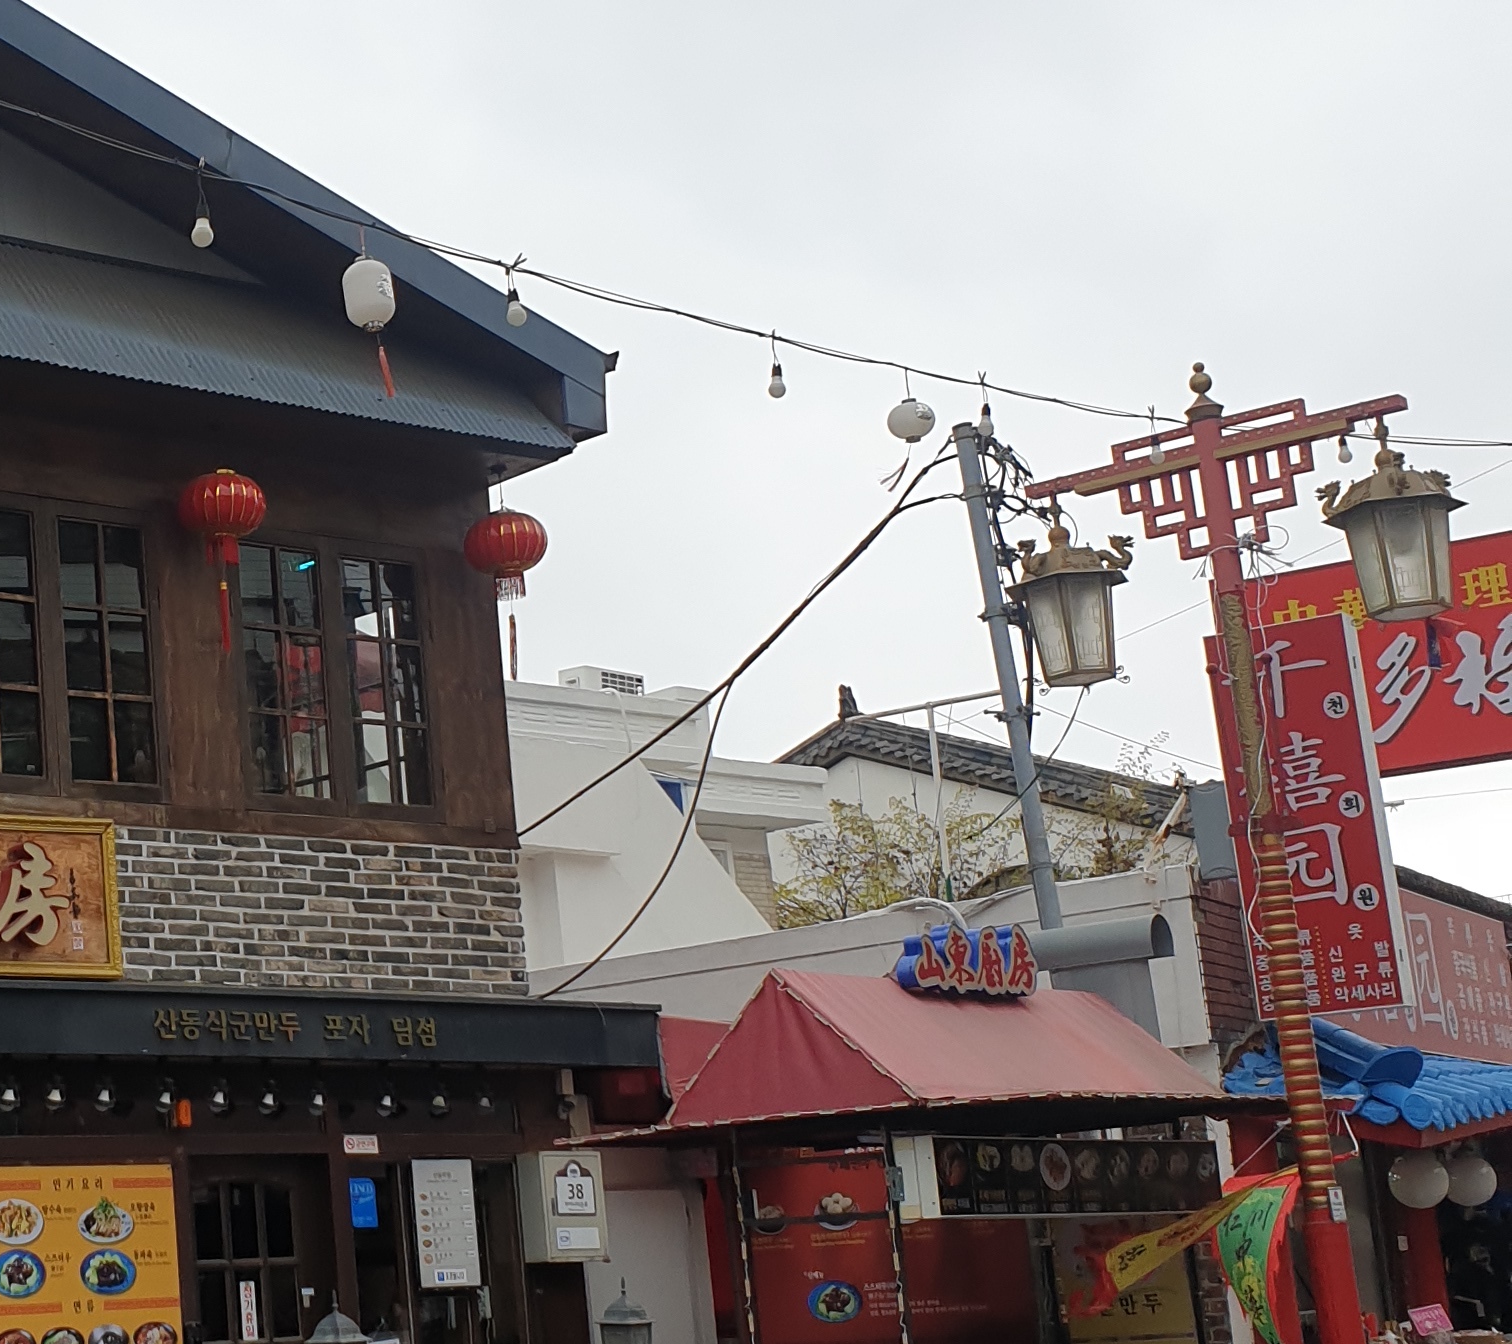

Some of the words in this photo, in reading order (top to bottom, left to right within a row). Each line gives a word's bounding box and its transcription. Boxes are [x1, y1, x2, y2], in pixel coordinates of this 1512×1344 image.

[1335, 981, 1397, 1003] 악세사리
[154, 1008, 302, 1043] 산동식군만두
[323, 1014, 372, 1045] 포자
[391, 1017, 438, 1048] 딤섬
[567, 1183, 584, 1200] 38
